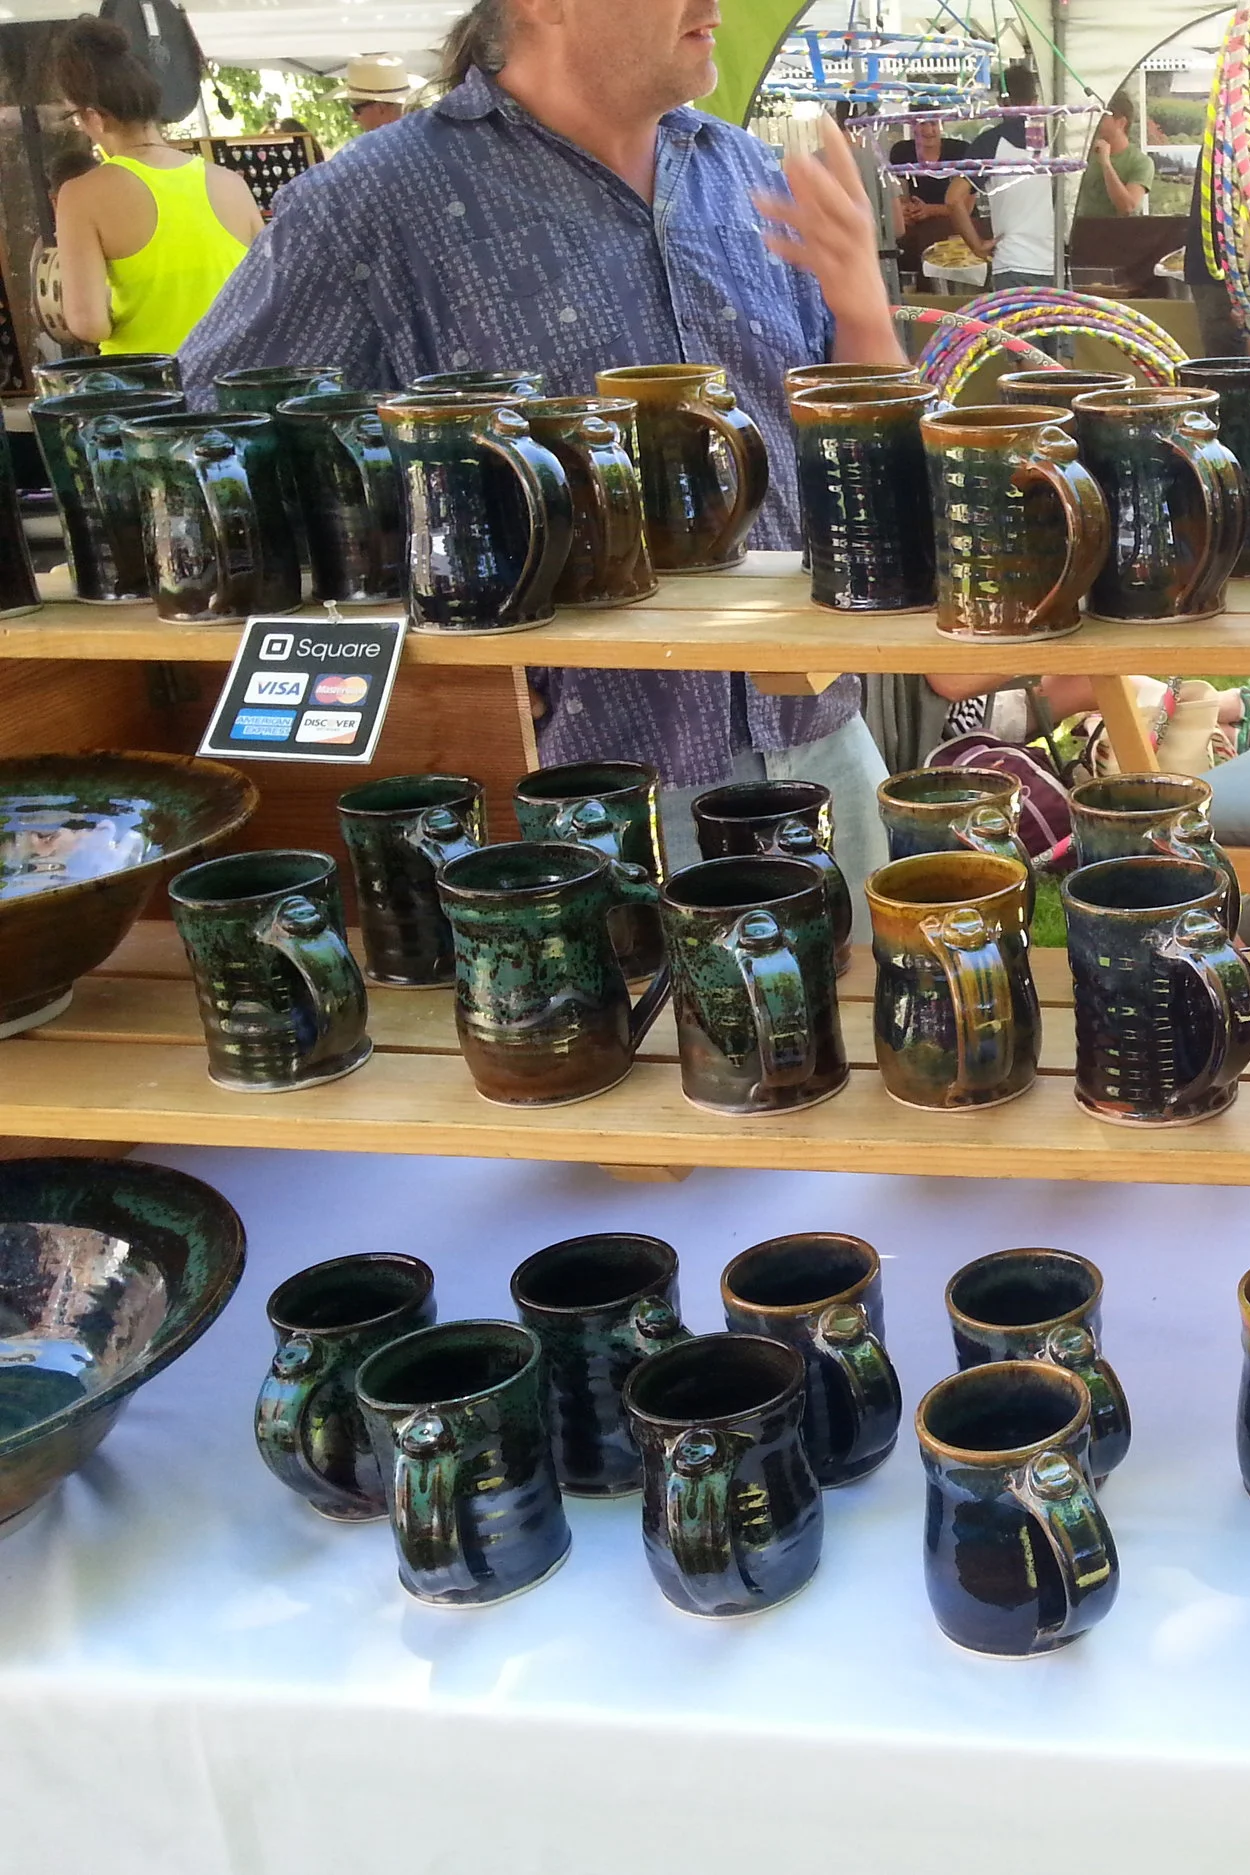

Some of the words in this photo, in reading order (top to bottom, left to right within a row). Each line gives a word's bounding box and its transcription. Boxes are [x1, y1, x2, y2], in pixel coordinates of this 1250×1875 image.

[296, 638, 381, 661] Square
[258, 681, 300, 695] VISA
[315, 684, 365, 695] Master
